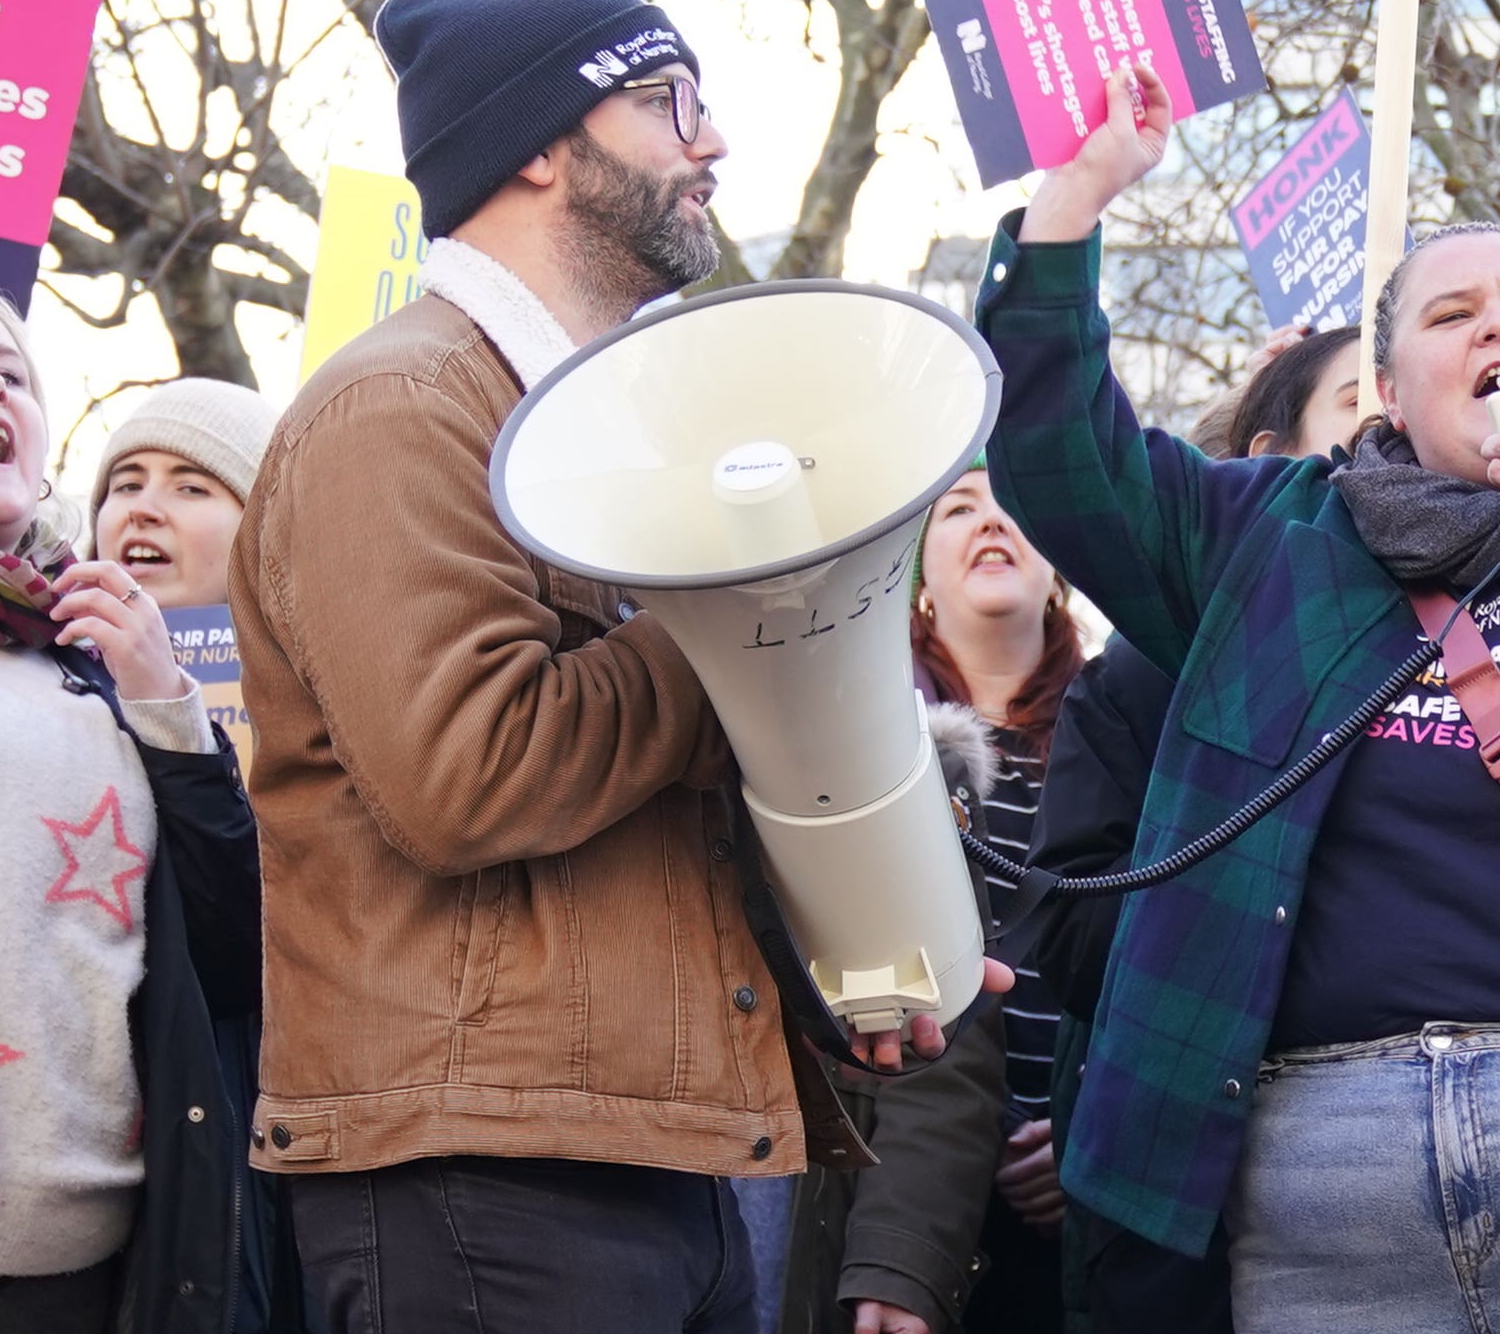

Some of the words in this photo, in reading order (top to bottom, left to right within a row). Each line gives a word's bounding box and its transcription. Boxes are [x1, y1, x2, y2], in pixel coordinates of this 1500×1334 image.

[1027, 39, 1055, 97] lives
[1185, 6, 1214, 59] LIVES
[1043, 21, 1089, 139] shortages
[1249, 117, 1349, 233] HONK
[1278, 214, 1297, 244] IF
[1298, 166, 1342, 216] YOU
[1272, 169, 1362, 276] SUPPORT
[1279, 235, 1329, 295] FAIR
[1329, 188, 1368, 242] PAY
[1310, 235, 1356, 289] FOR
[172, 631, 205, 648] AIR
[207, 627, 235, 646] PA
